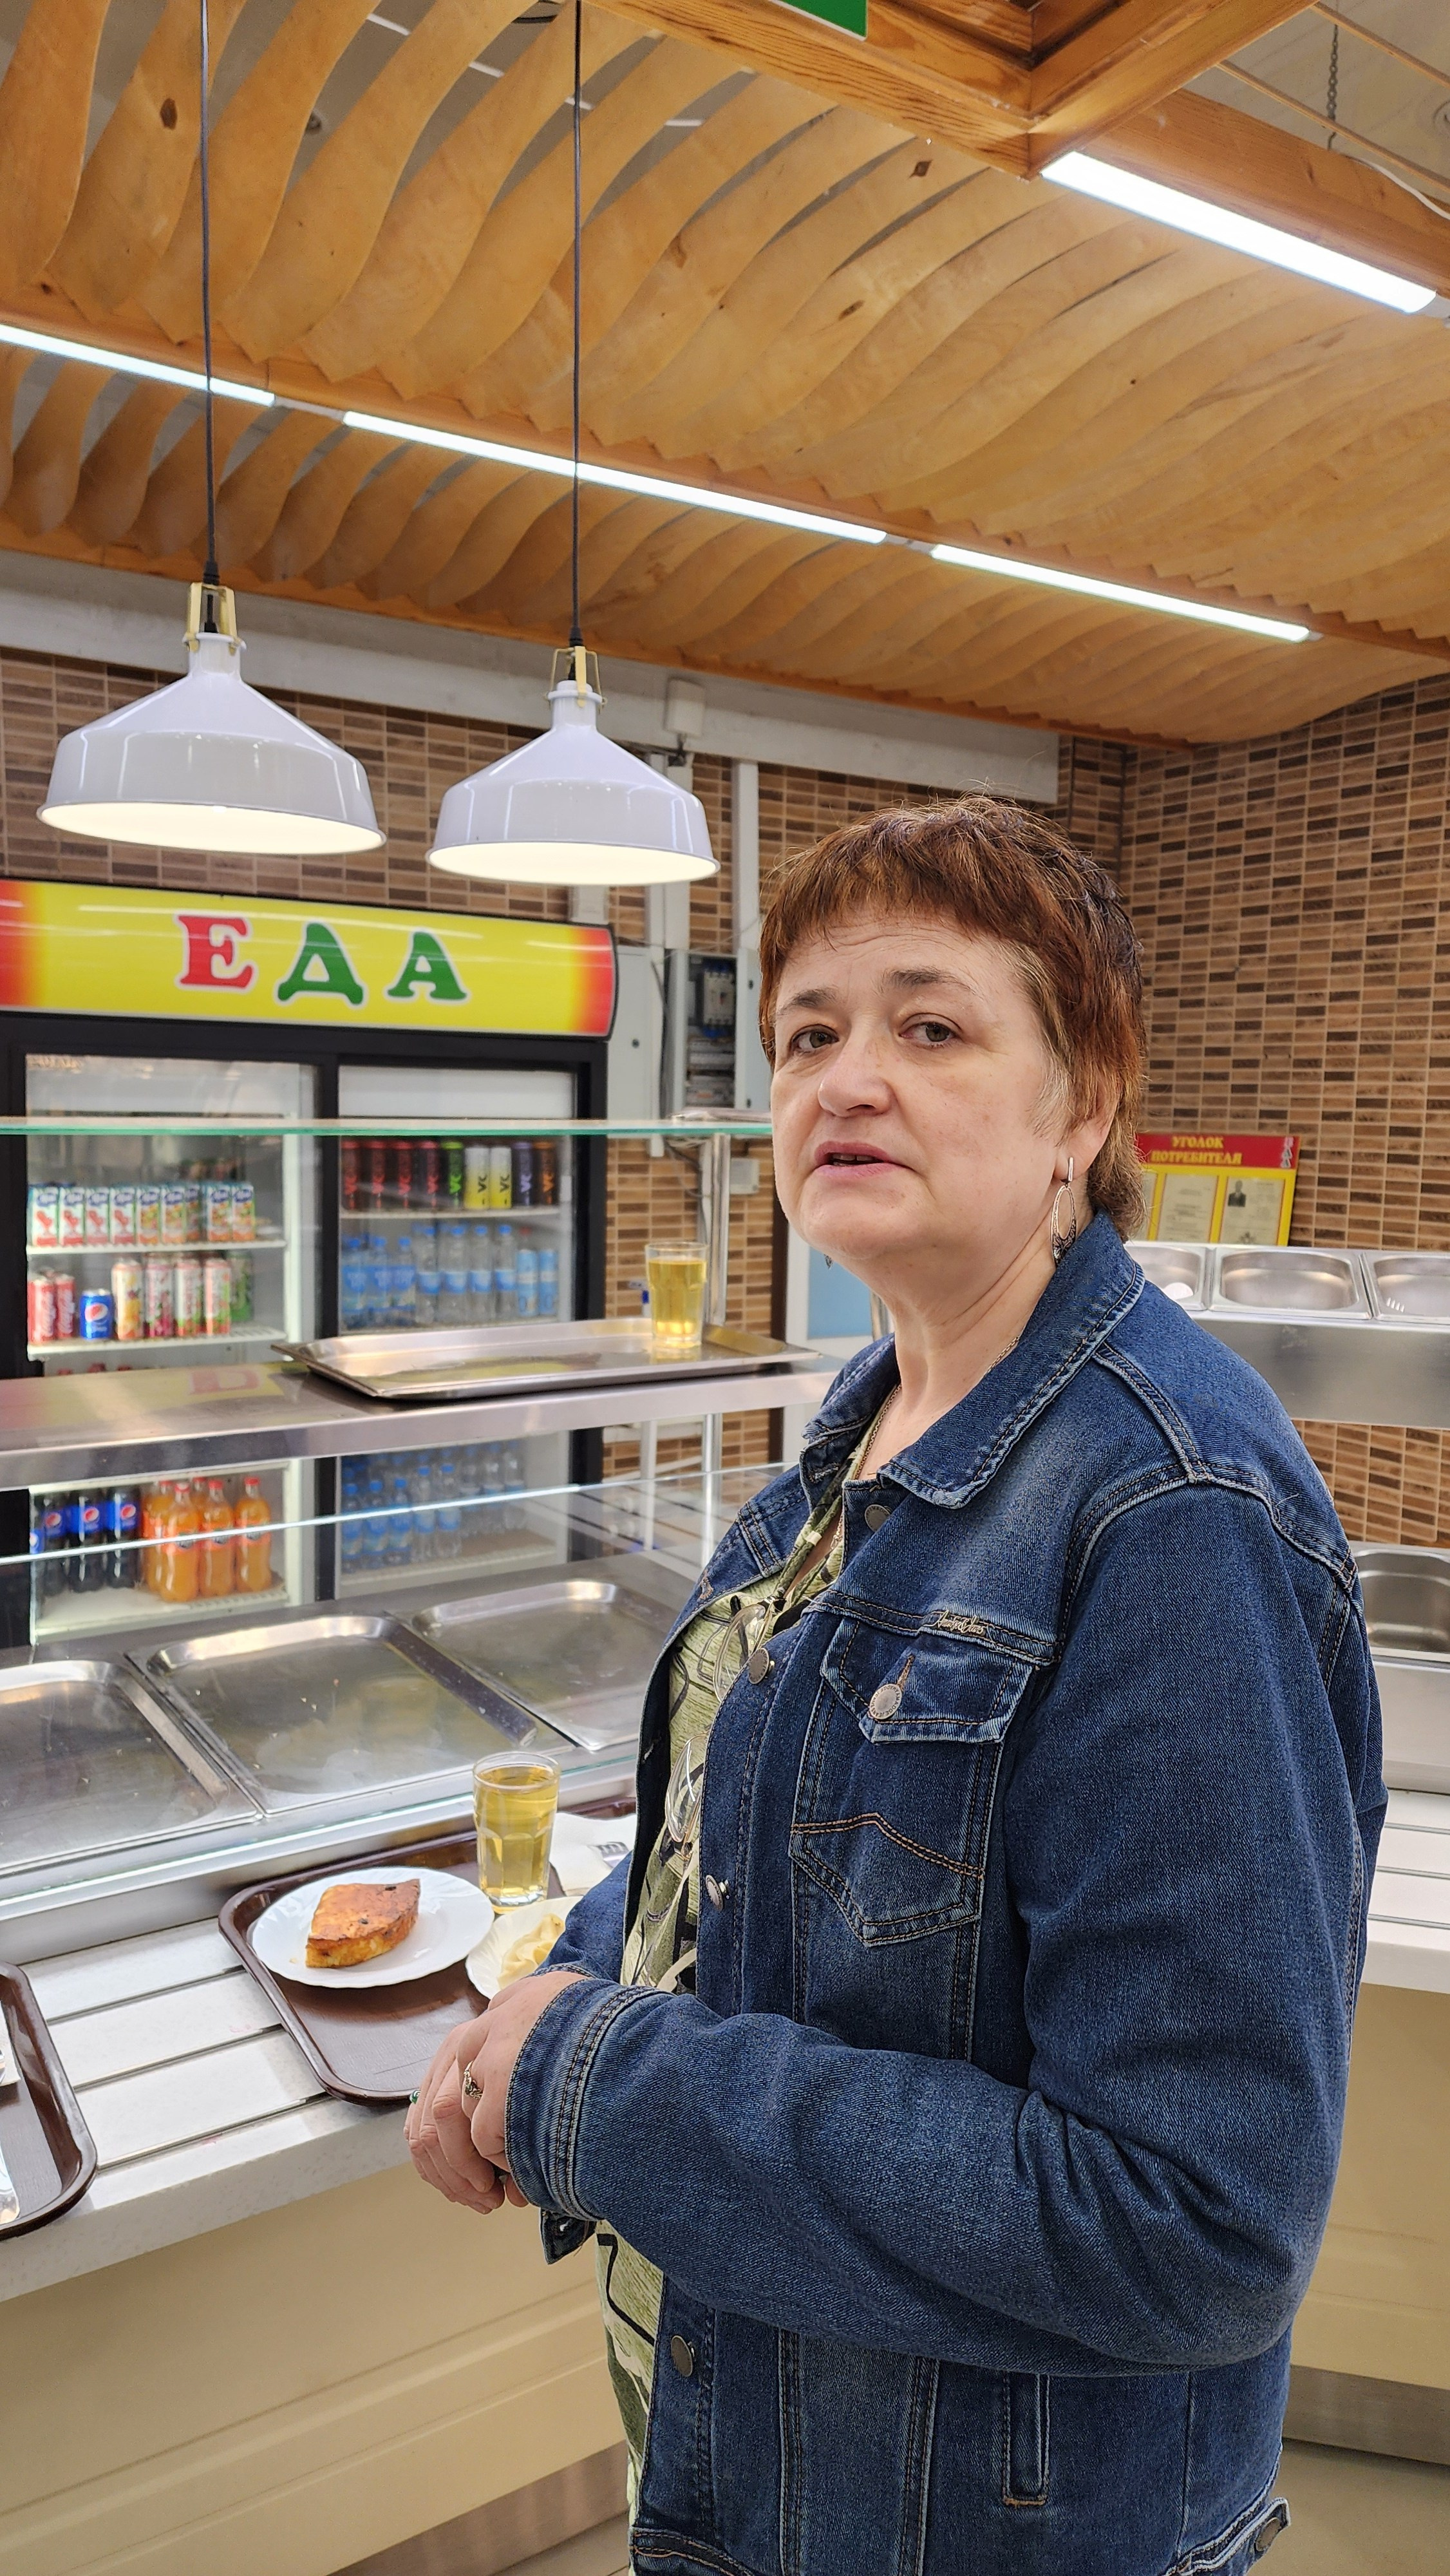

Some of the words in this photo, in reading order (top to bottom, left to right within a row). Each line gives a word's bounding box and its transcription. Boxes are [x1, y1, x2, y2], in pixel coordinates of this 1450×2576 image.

[176, 914, 469, 1006] ЕДА
[1171, 1136, 1224, 1149] УГОЛОК
[1151, 1150, 1243, 1165] ПОТРЕБИТЕЛЯ
